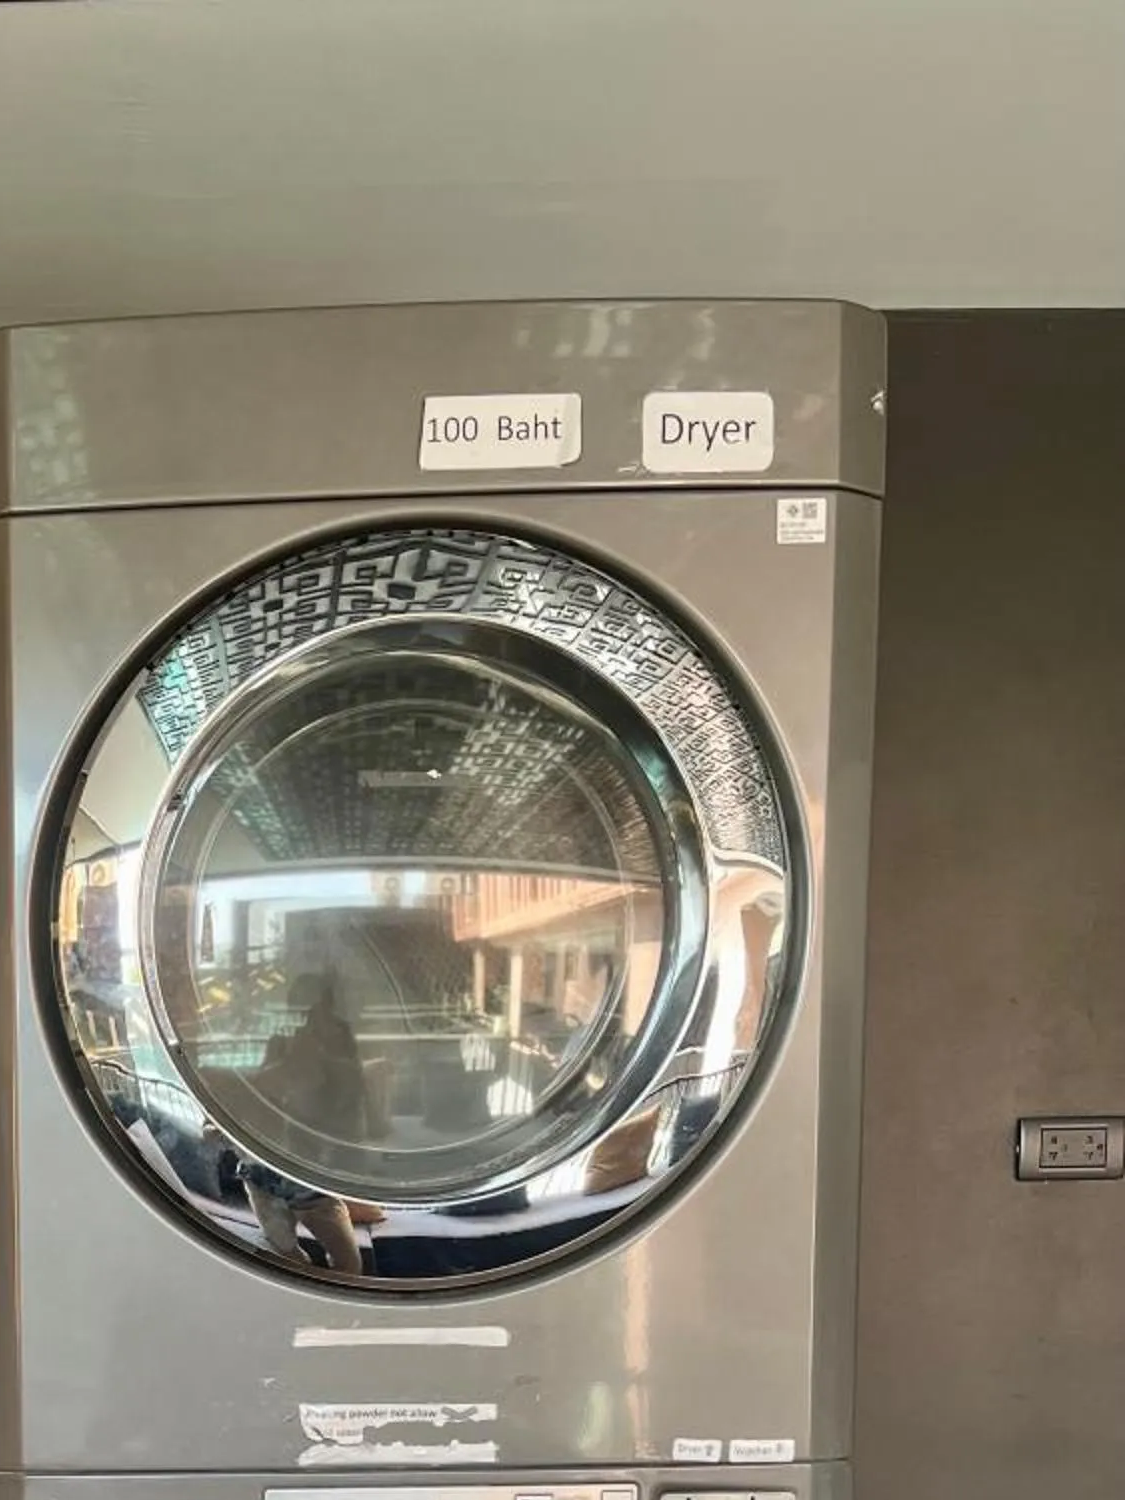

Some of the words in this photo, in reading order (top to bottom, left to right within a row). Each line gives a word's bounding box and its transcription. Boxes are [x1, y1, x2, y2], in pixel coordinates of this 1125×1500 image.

[426, 416, 479, 444] 100
[496, 413, 563, 442] Baht
[660, 412, 757, 452] Dryer
[349, 1408, 388, 1420] powder
[390, 1408, 408, 1418] not
